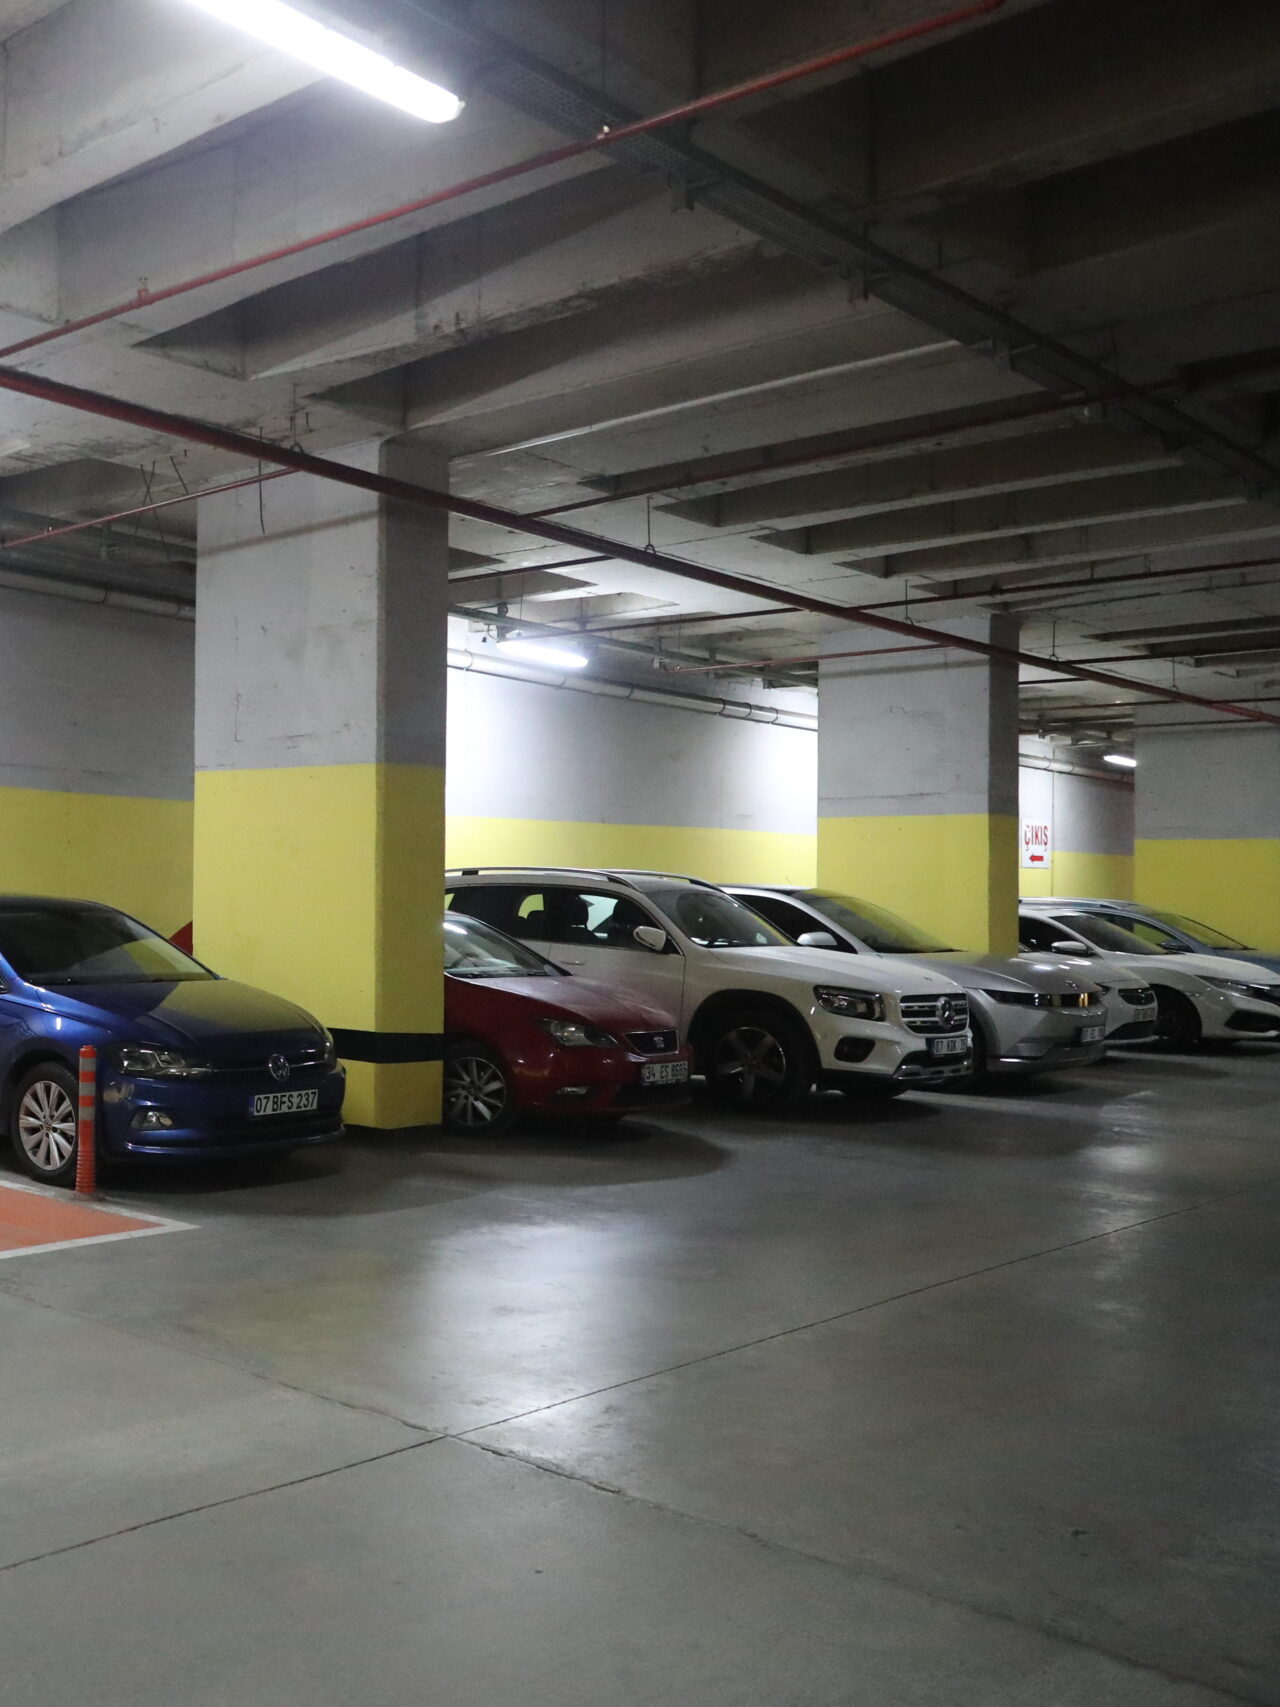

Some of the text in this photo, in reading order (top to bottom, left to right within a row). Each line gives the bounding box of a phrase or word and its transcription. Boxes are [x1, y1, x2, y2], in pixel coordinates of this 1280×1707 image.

[1024, 824, 1049, 852] ÇIKIŞ
[646, 1065, 656, 1080] 34
[256, 1091, 317, 1113] 07 BFS 237
